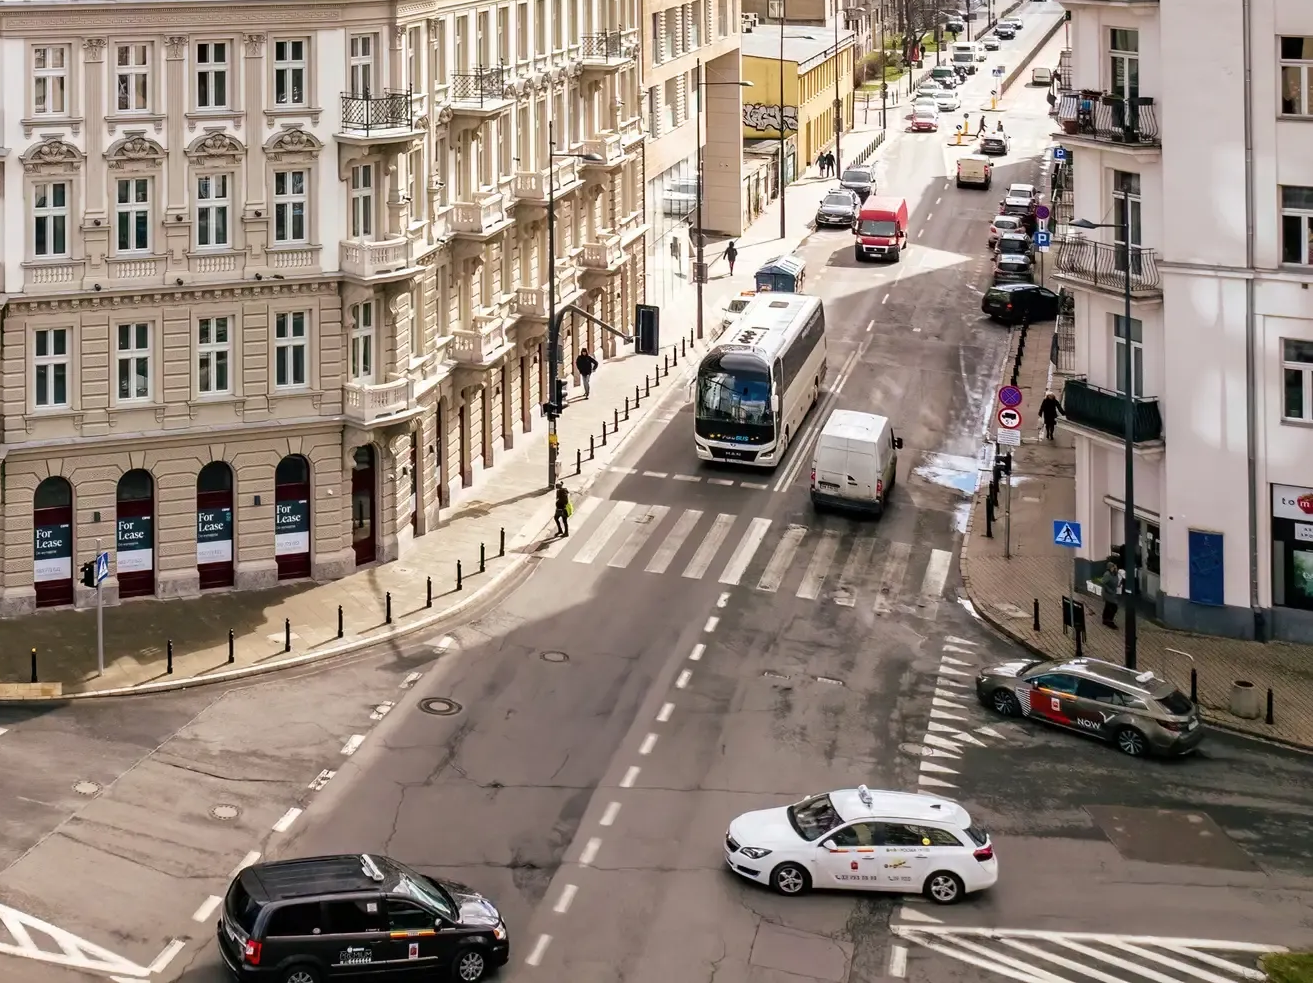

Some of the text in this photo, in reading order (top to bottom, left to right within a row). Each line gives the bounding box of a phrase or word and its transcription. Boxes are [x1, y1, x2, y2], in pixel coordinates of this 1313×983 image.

[1056, 149, 1064, 158] P
[1038, 234, 1047, 244] P
[276, 505, 291, 514] For
[198, 512, 214, 522] For
[276, 514, 301, 524] Lease
[118, 521, 134, 531] For
[198, 522, 224, 532] Lease
[36, 529, 52, 539] For
[118, 531, 144, 541] Lease
[36, 539, 63, 549] Lease
[1077, 718, 1100, 729] NOW
